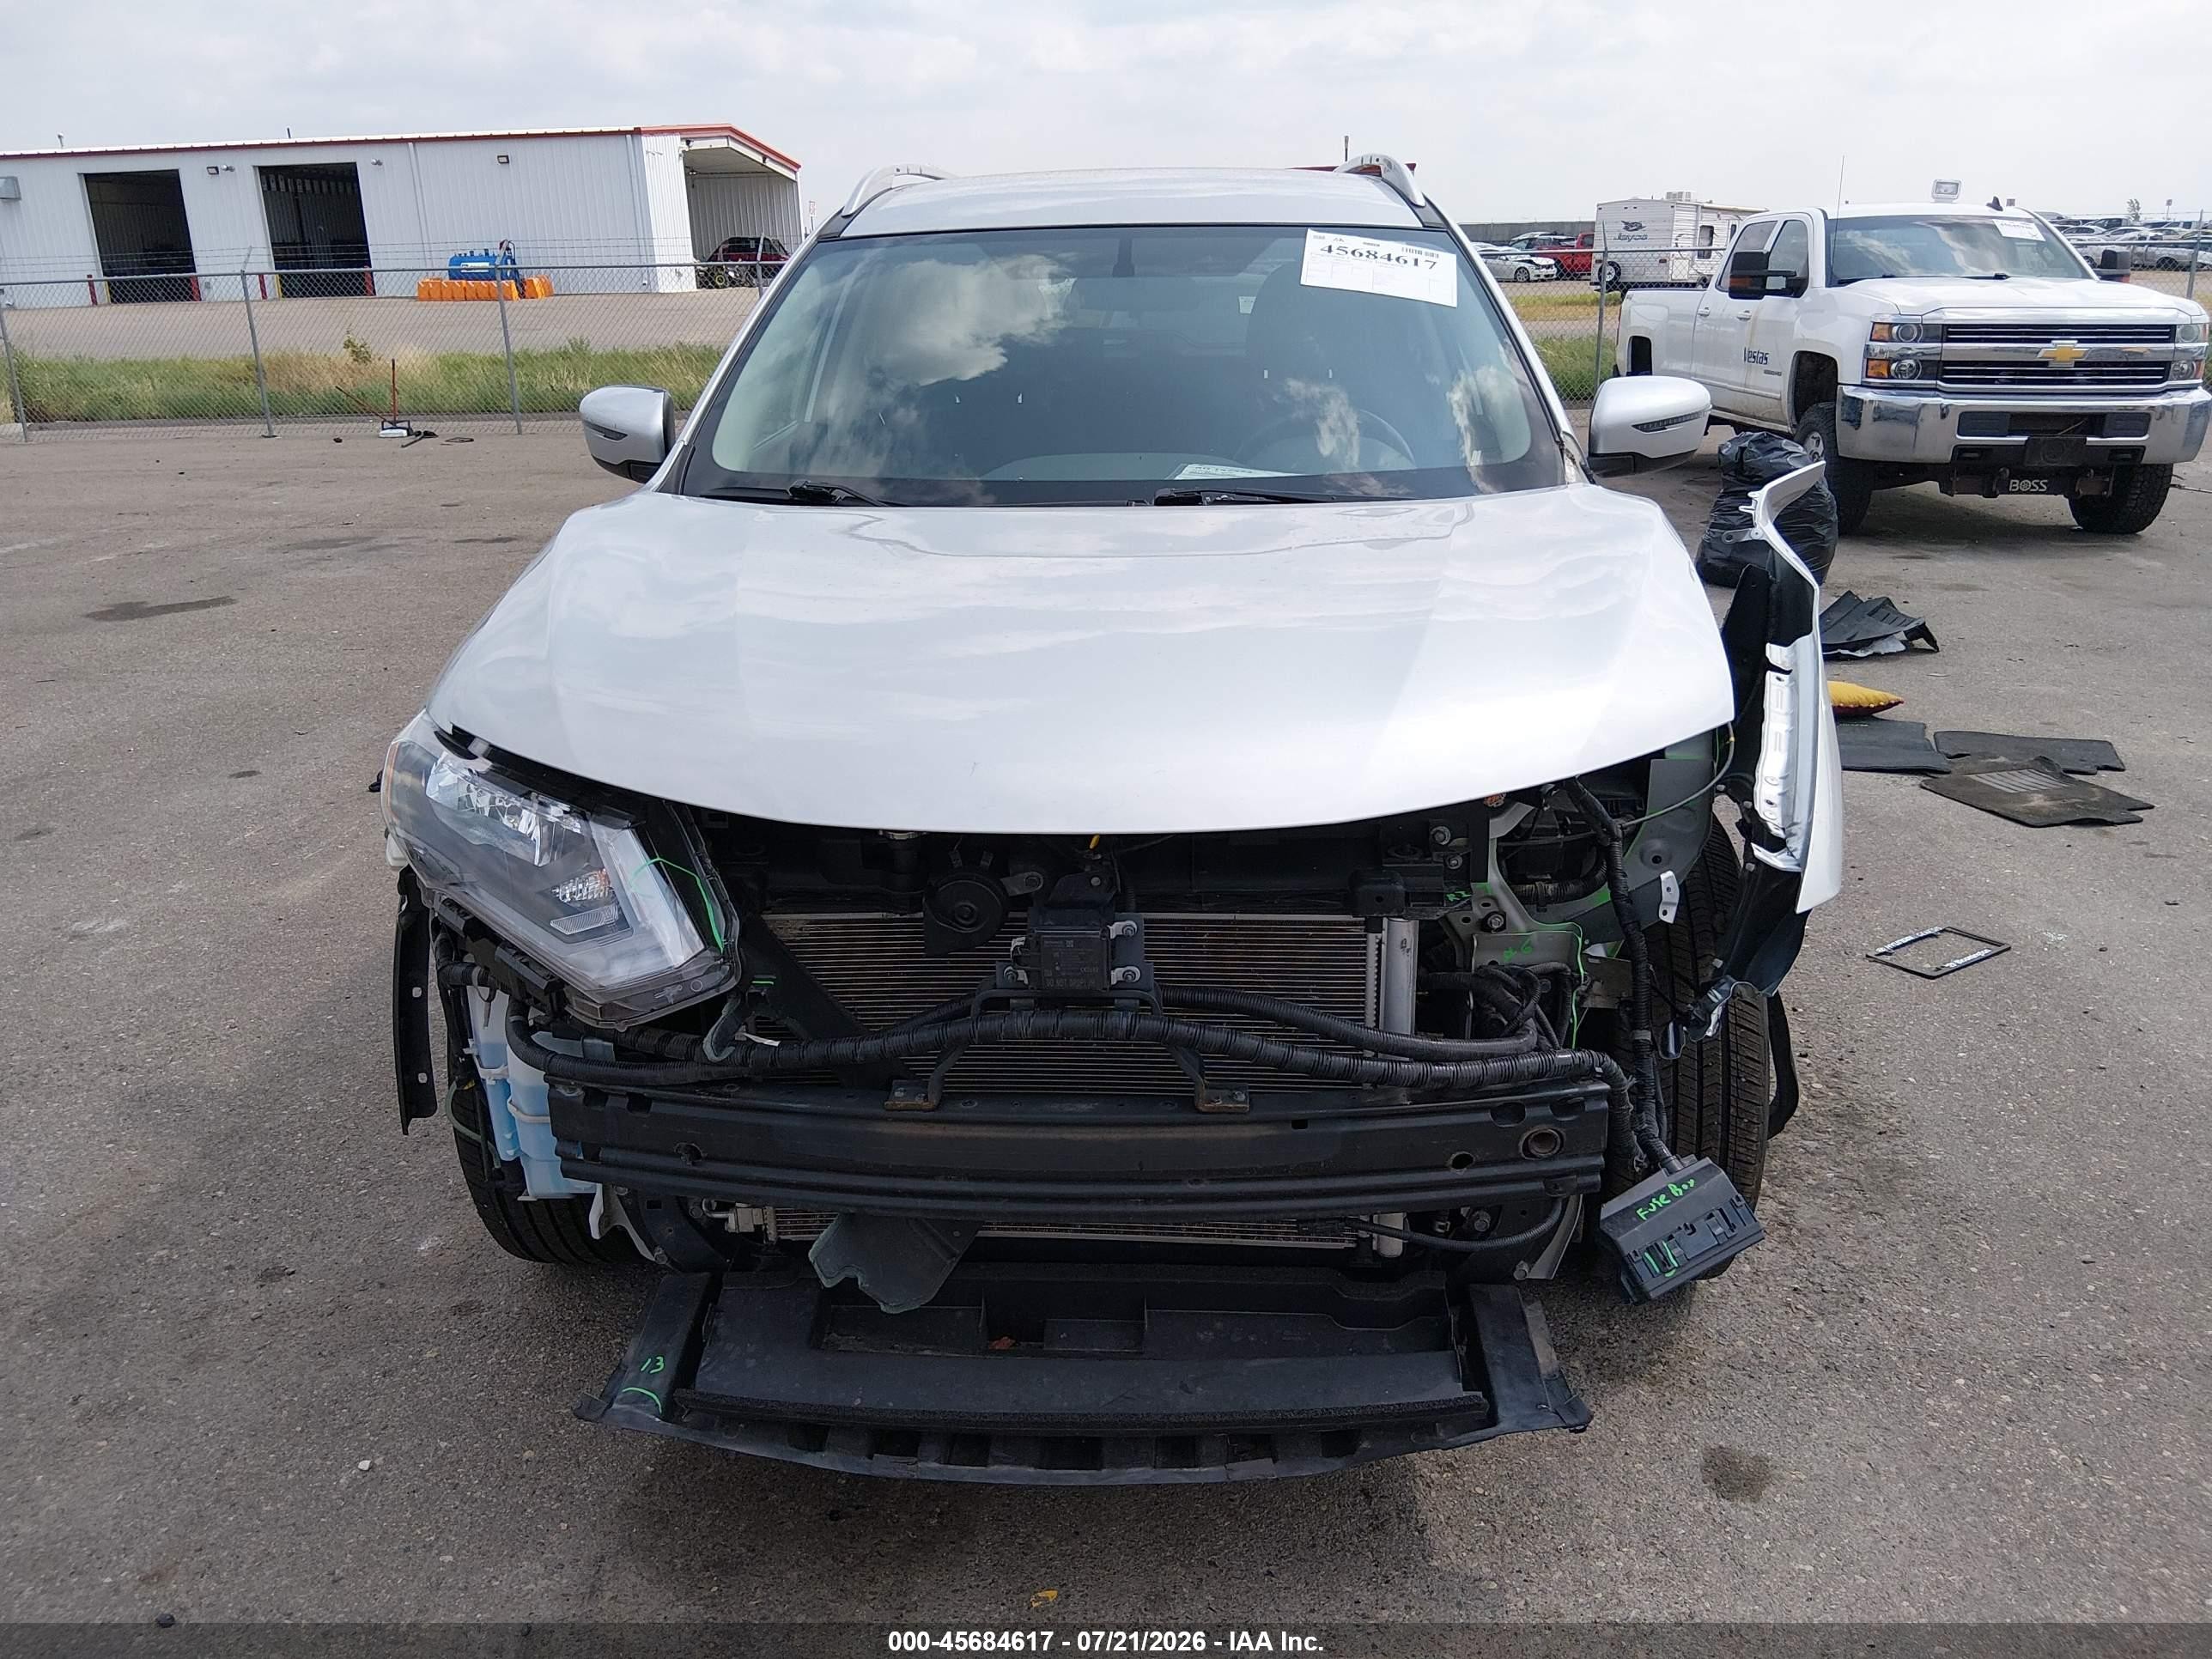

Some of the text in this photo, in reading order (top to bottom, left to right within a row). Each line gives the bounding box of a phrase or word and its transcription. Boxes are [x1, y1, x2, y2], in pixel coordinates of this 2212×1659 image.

[1320, 244, 1437, 270] 45684617
[2009, 479, 2048, 492] BOSS
[1636, 1194, 1672, 1220] Fuse
[640, 1355, 665, 1374] 13
